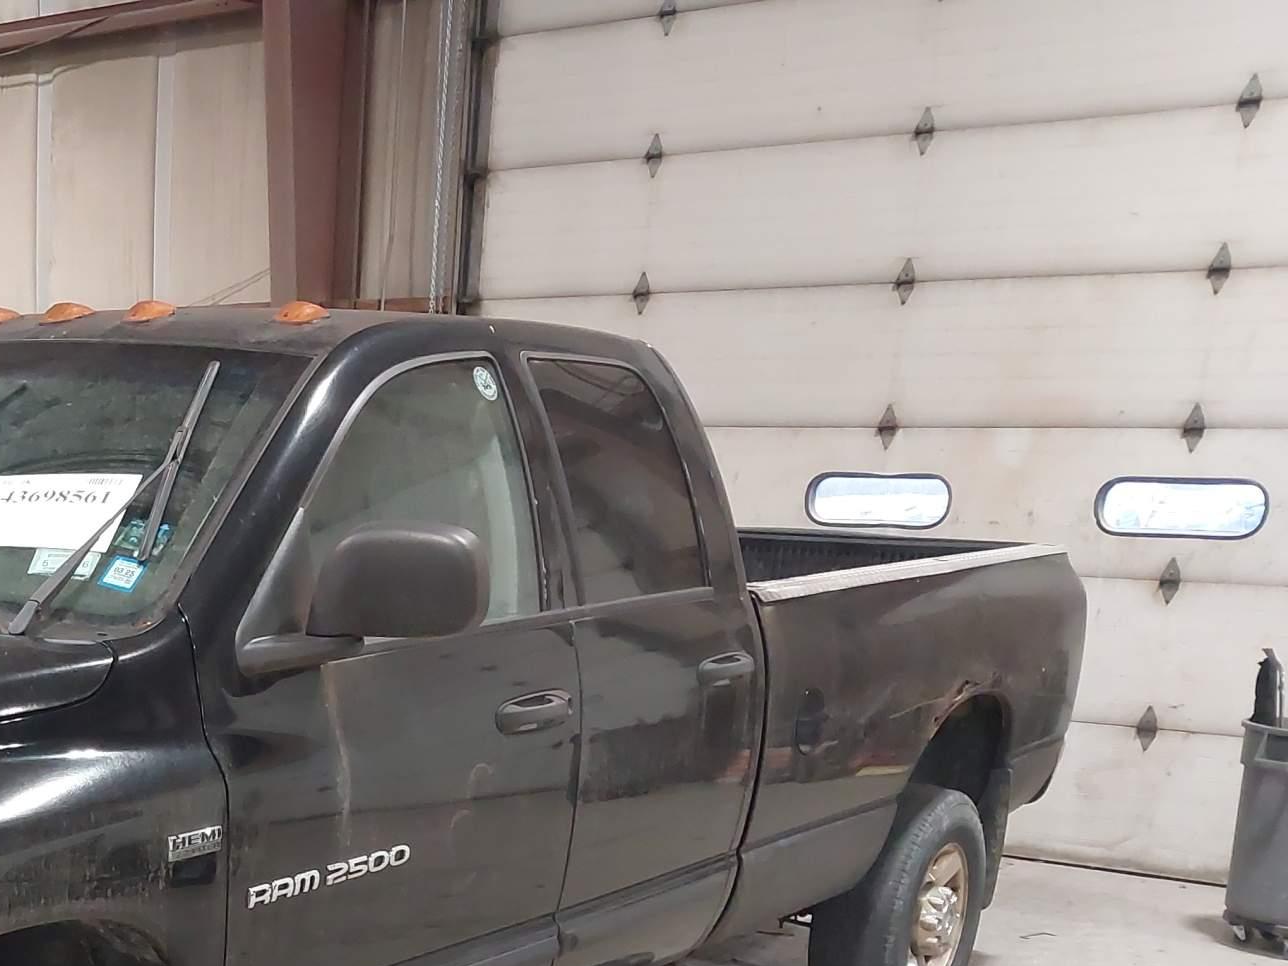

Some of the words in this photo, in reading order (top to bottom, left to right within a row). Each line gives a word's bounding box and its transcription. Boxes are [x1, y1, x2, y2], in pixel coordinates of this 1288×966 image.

[0, 489, 112, 504] 43698561
[171, 828, 223, 851] HEMI
[246, 869, 321, 910] RAM
[325, 844, 412, 887] 2500
